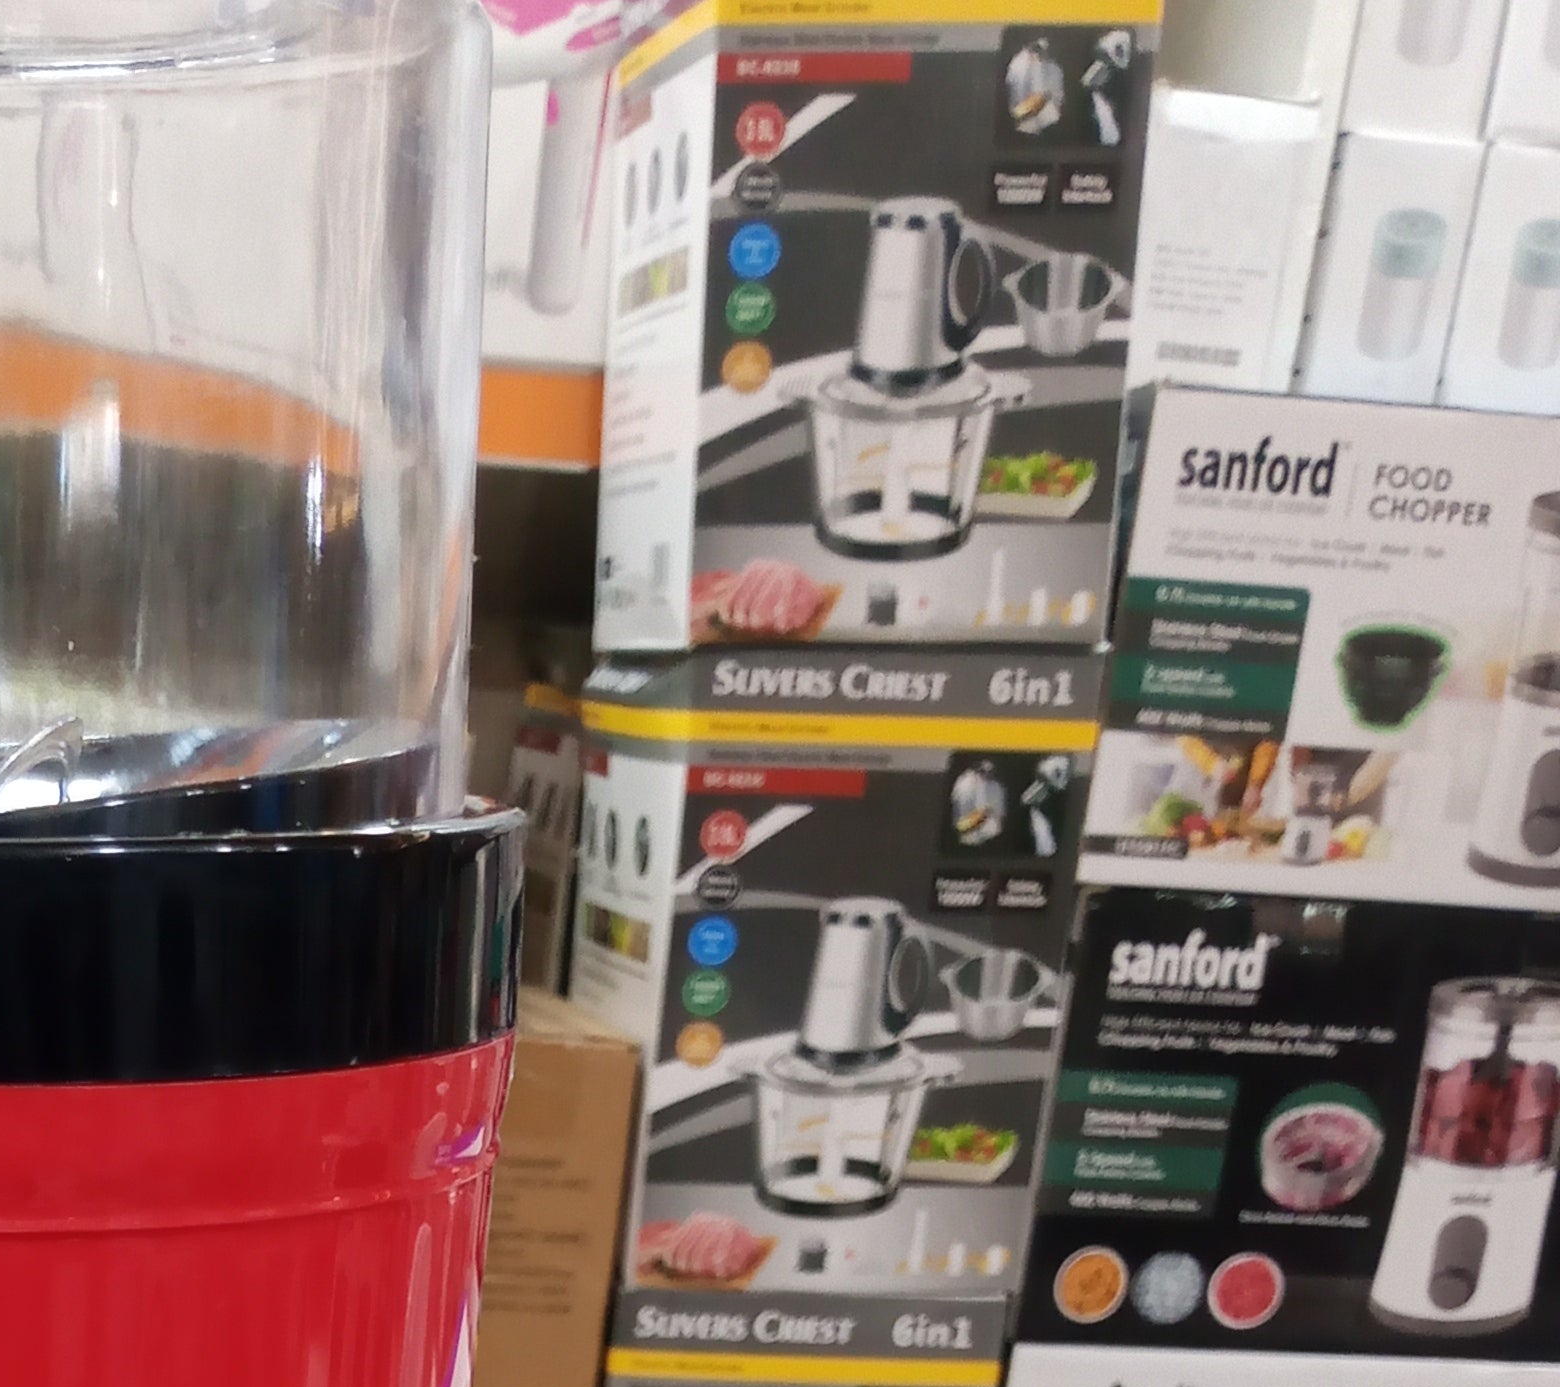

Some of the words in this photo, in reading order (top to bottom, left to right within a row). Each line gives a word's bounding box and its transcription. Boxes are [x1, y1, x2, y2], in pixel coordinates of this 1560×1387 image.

[1177, 435, 1340, 498] sanford
[1375, 463, 1453, 492] FOOD
[1369, 494, 1491, 526] CHOPPER
[989, 667, 1073, 706] 6in1
[1109, 929, 1272, 990] sanford
[892, 1312, 973, 1350] 6in1
